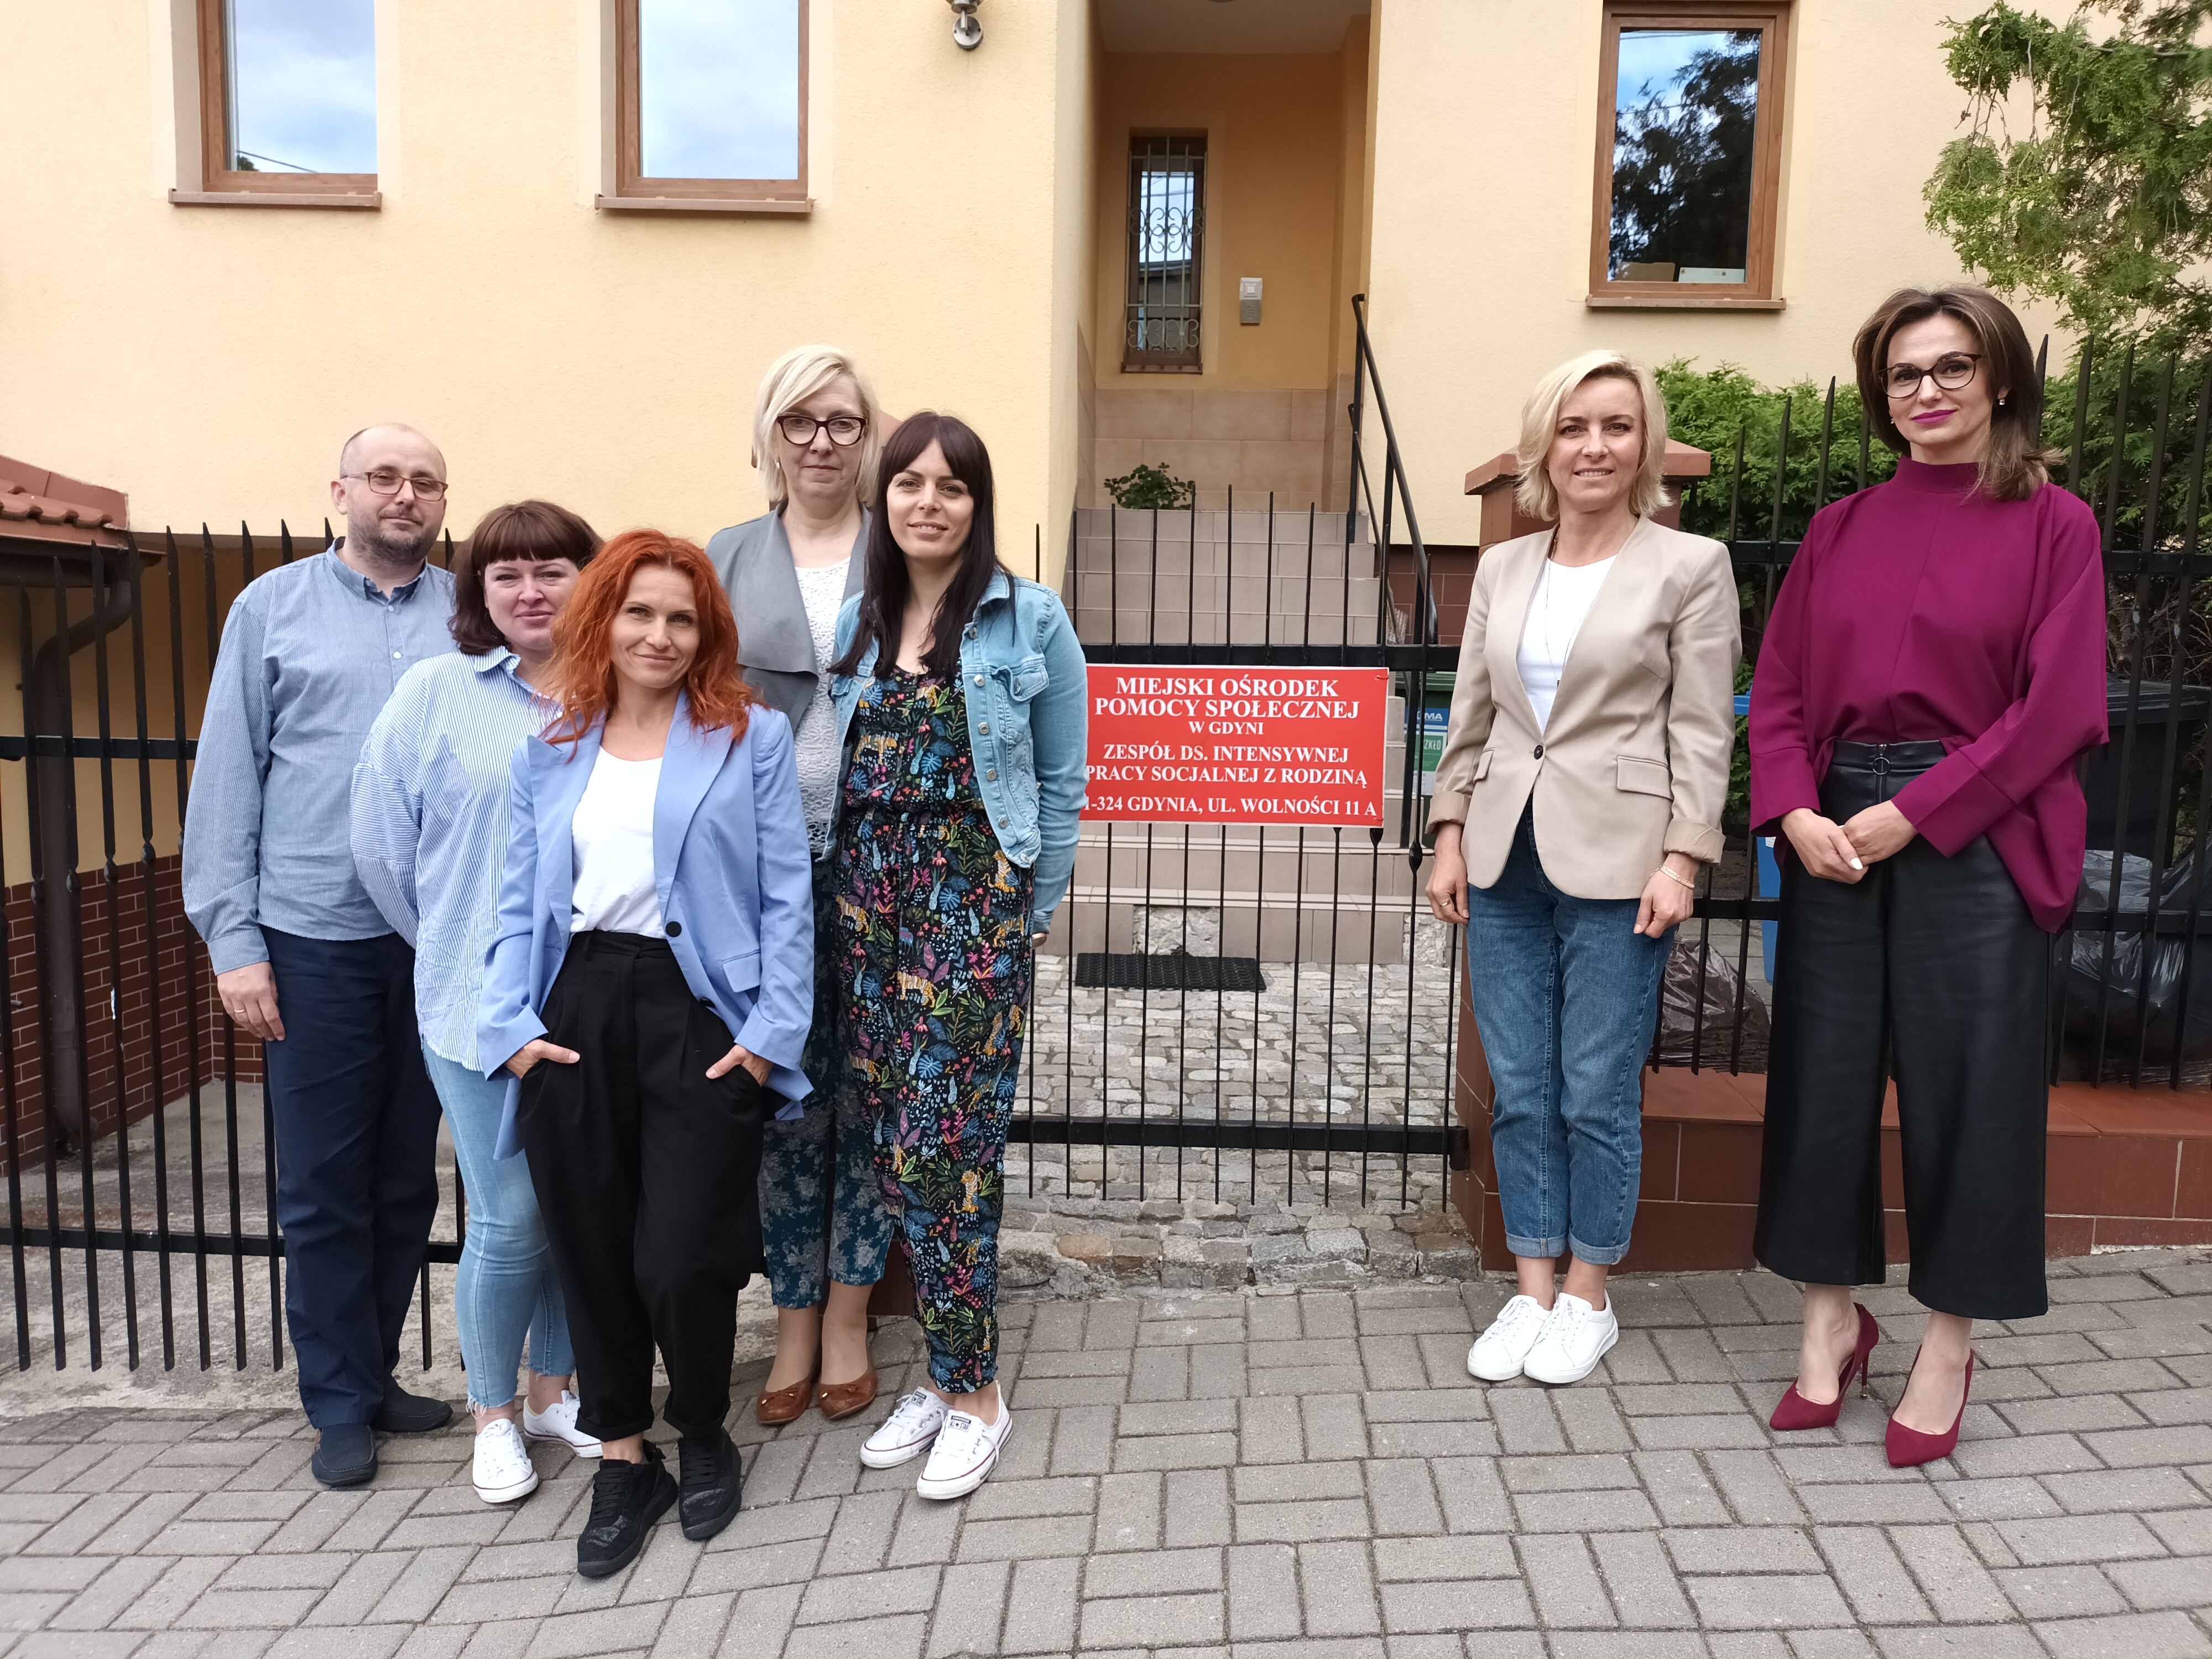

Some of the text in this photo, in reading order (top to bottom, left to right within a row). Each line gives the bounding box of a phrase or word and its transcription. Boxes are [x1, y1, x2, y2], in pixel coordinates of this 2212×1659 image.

[1116, 674, 1339, 697] MIEJSKI OŚRODEK
[1095, 698, 1359, 719] POMOCY SPOŁECZNEJ
[1188, 721, 1264, 735] W GDYNI
[1103, 740, 1349, 763] ZESPÓŁ DS. INTENSYWNEJ
[1423, 739, 1442, 750] ZKŁO
[1086, 765, 1368, 789] PRACY SOCJALNEJ Z RODZINĄ
[1084, 795, 1377, 816] 1-324 GDYNIA, UL. WOLNOŚCI 11 A
